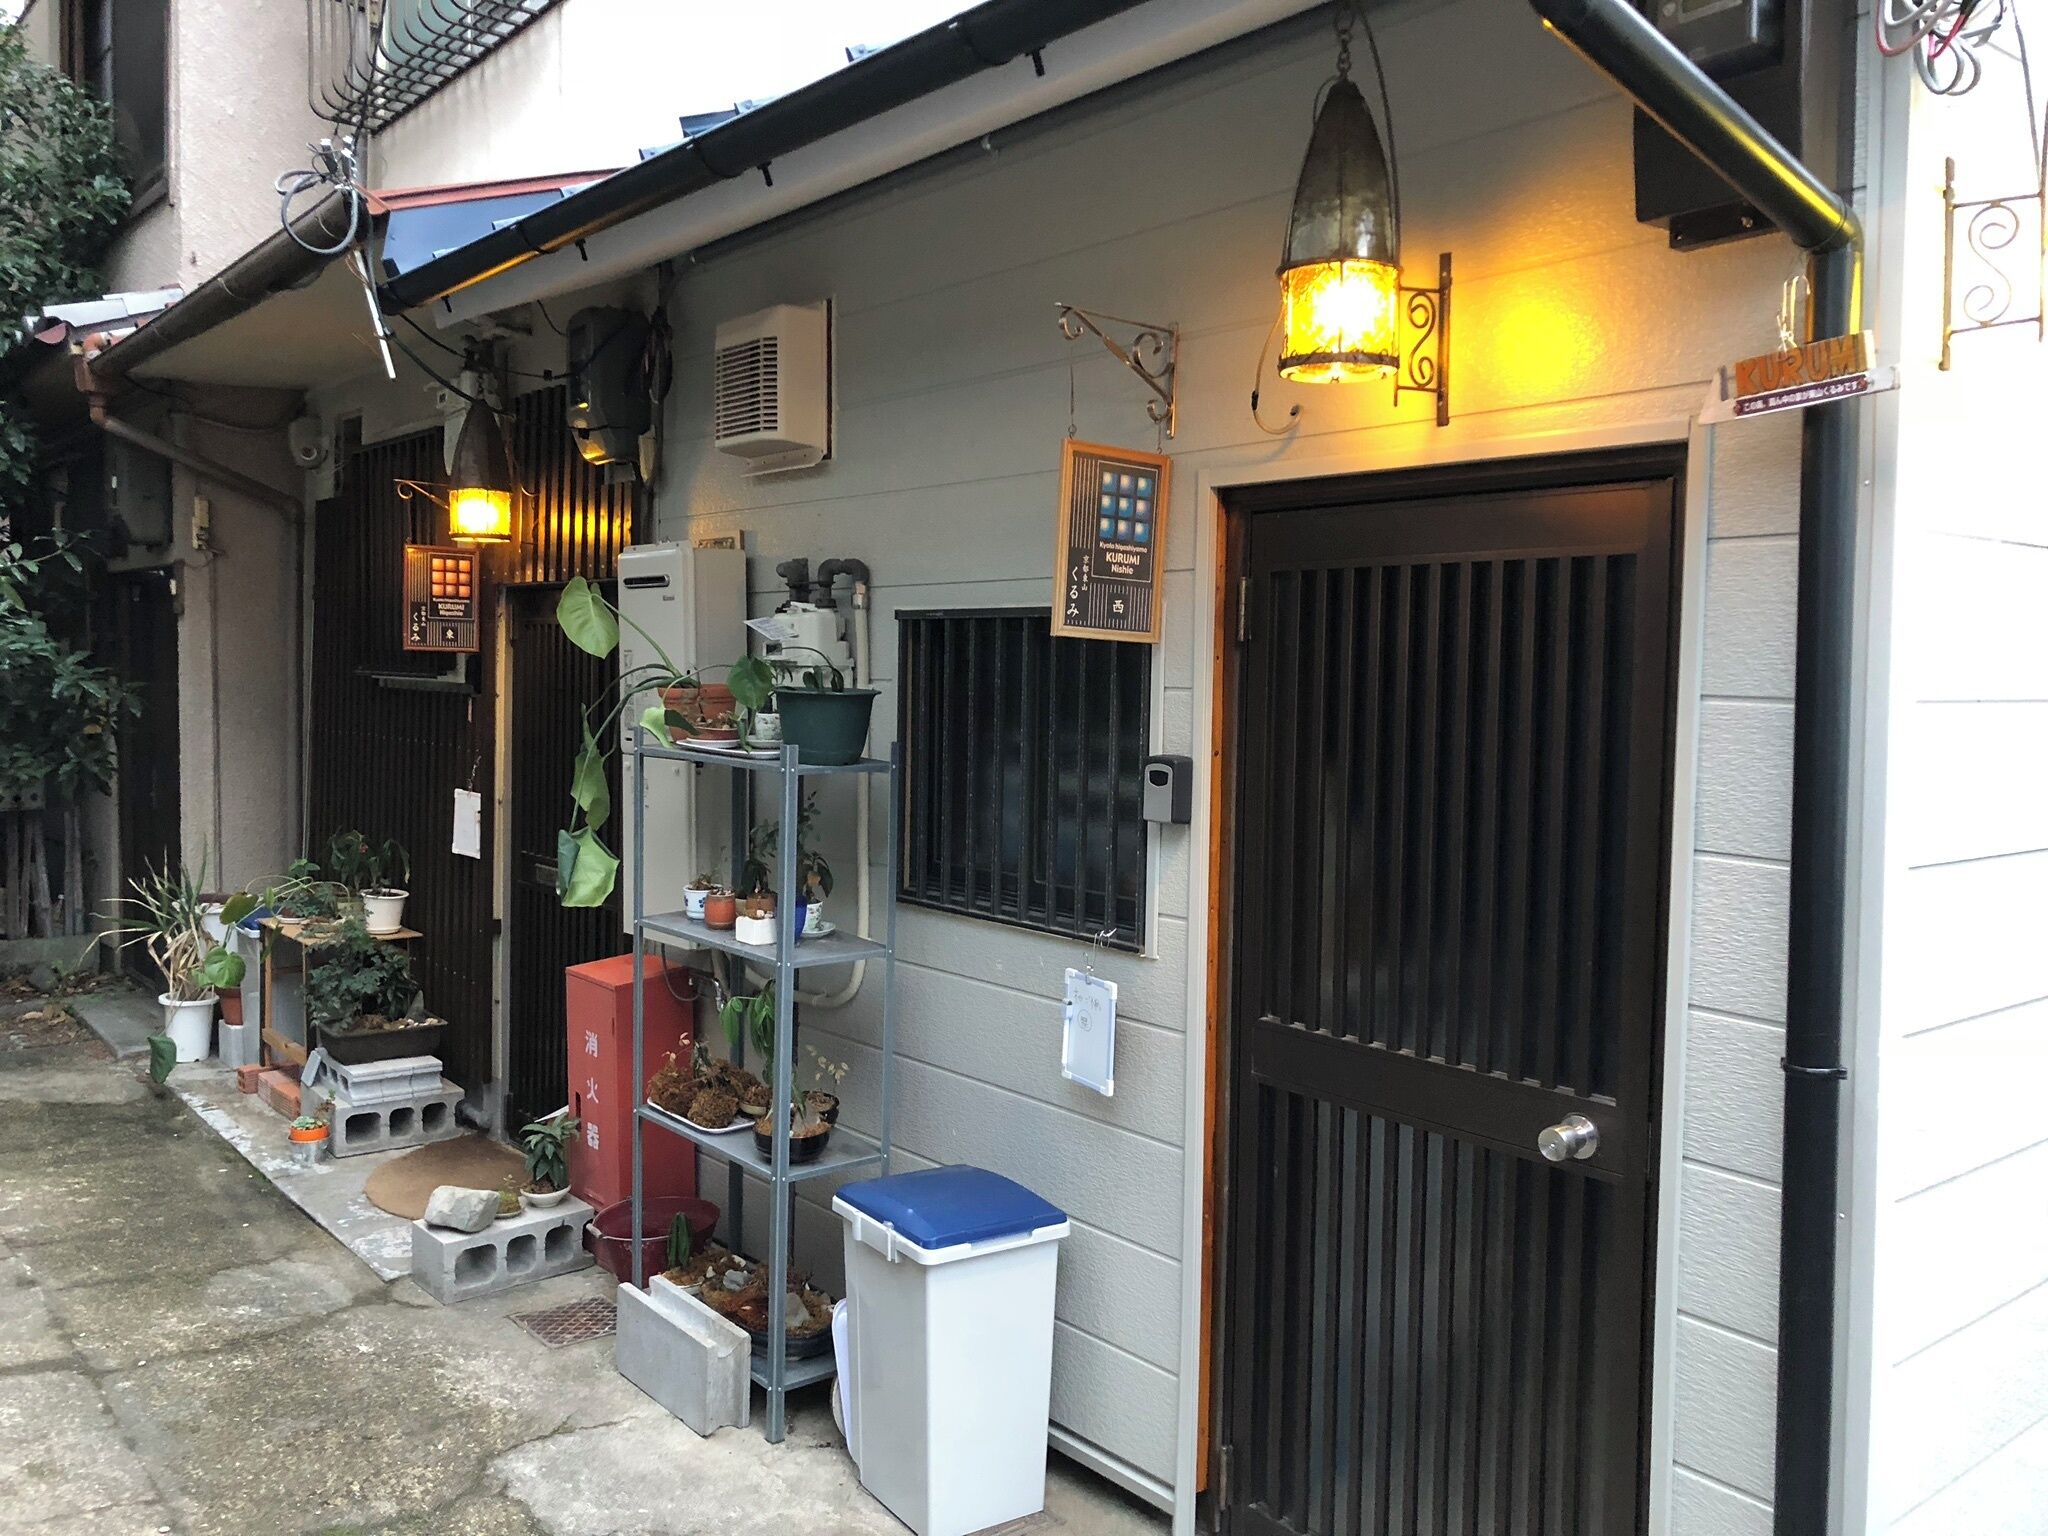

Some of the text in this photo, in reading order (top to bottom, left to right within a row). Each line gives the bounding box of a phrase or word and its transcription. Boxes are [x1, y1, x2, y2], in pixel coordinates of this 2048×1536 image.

[1736, 333, 1866, 397] KURUMI
[1105, 552, 1140, 566] KURUMI
[1111, 564, 1134, 575] Nishie
[1066, 566, 1080, 618] くるみ
[438, 603, 465, 611] KURUMI
[1112, 600, 1124, 614] 西
[585, 1029, 599, 1151] 消火器
